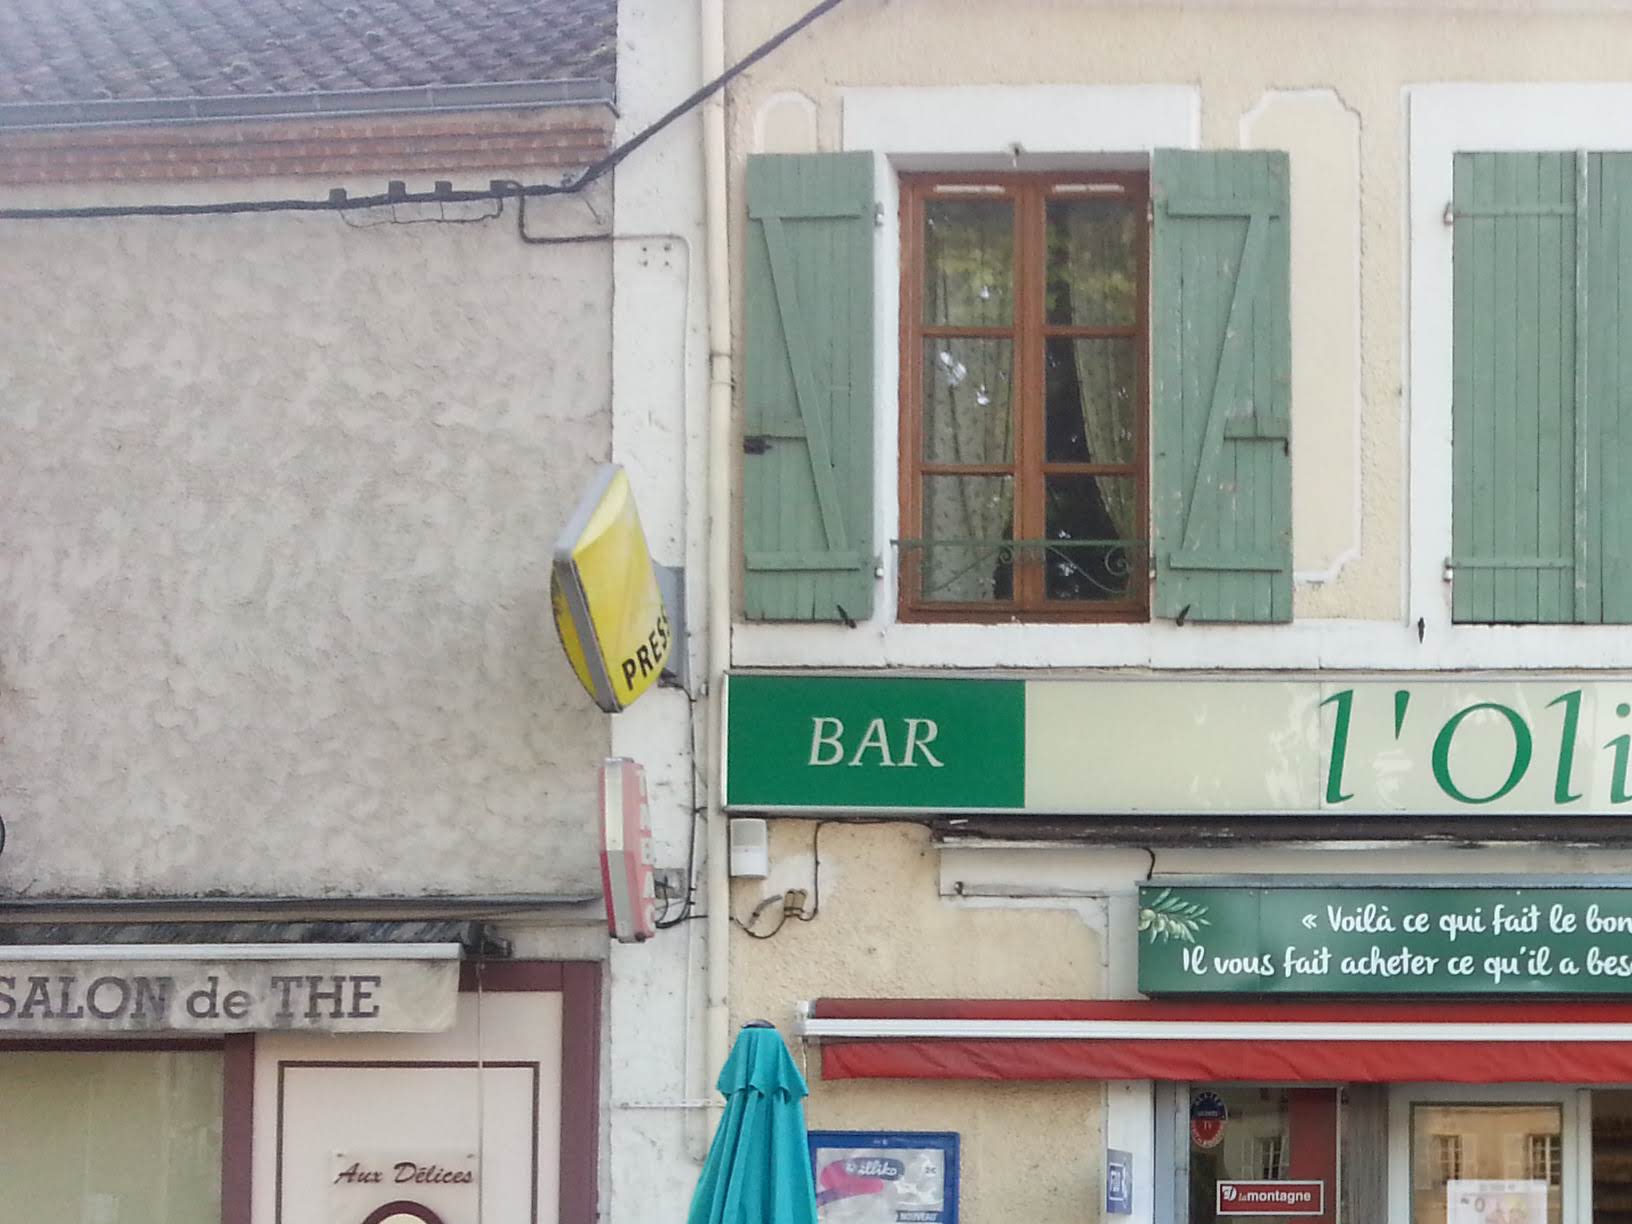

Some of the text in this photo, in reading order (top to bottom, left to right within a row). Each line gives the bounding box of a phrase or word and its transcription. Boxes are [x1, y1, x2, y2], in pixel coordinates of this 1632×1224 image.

[807, 716, 945, 768] BAR
[1326, 903, 1396, 934] Voilà
[1403, 912, 1431, 933] ce
[1438, 906, 1487, 942] qui
[1492, 903, 1542, 935] fait
[1549, 903, 1577, 934] le
[1182, 945, 1208, 976] Il
[1213, 953, 1275, 977] vous
[1282, 946, 1332, 978] fait
[1340, 945, 1440, 978] acheter
[1447, 955, 1474, 976] ce
[1483, 945, 1554, 984] qu'il
[1559, 957, 1580, 976] a
[0, 975, 381, 1019] SALON de THE
[333, 1161, 473, 1184] Aux Délices
